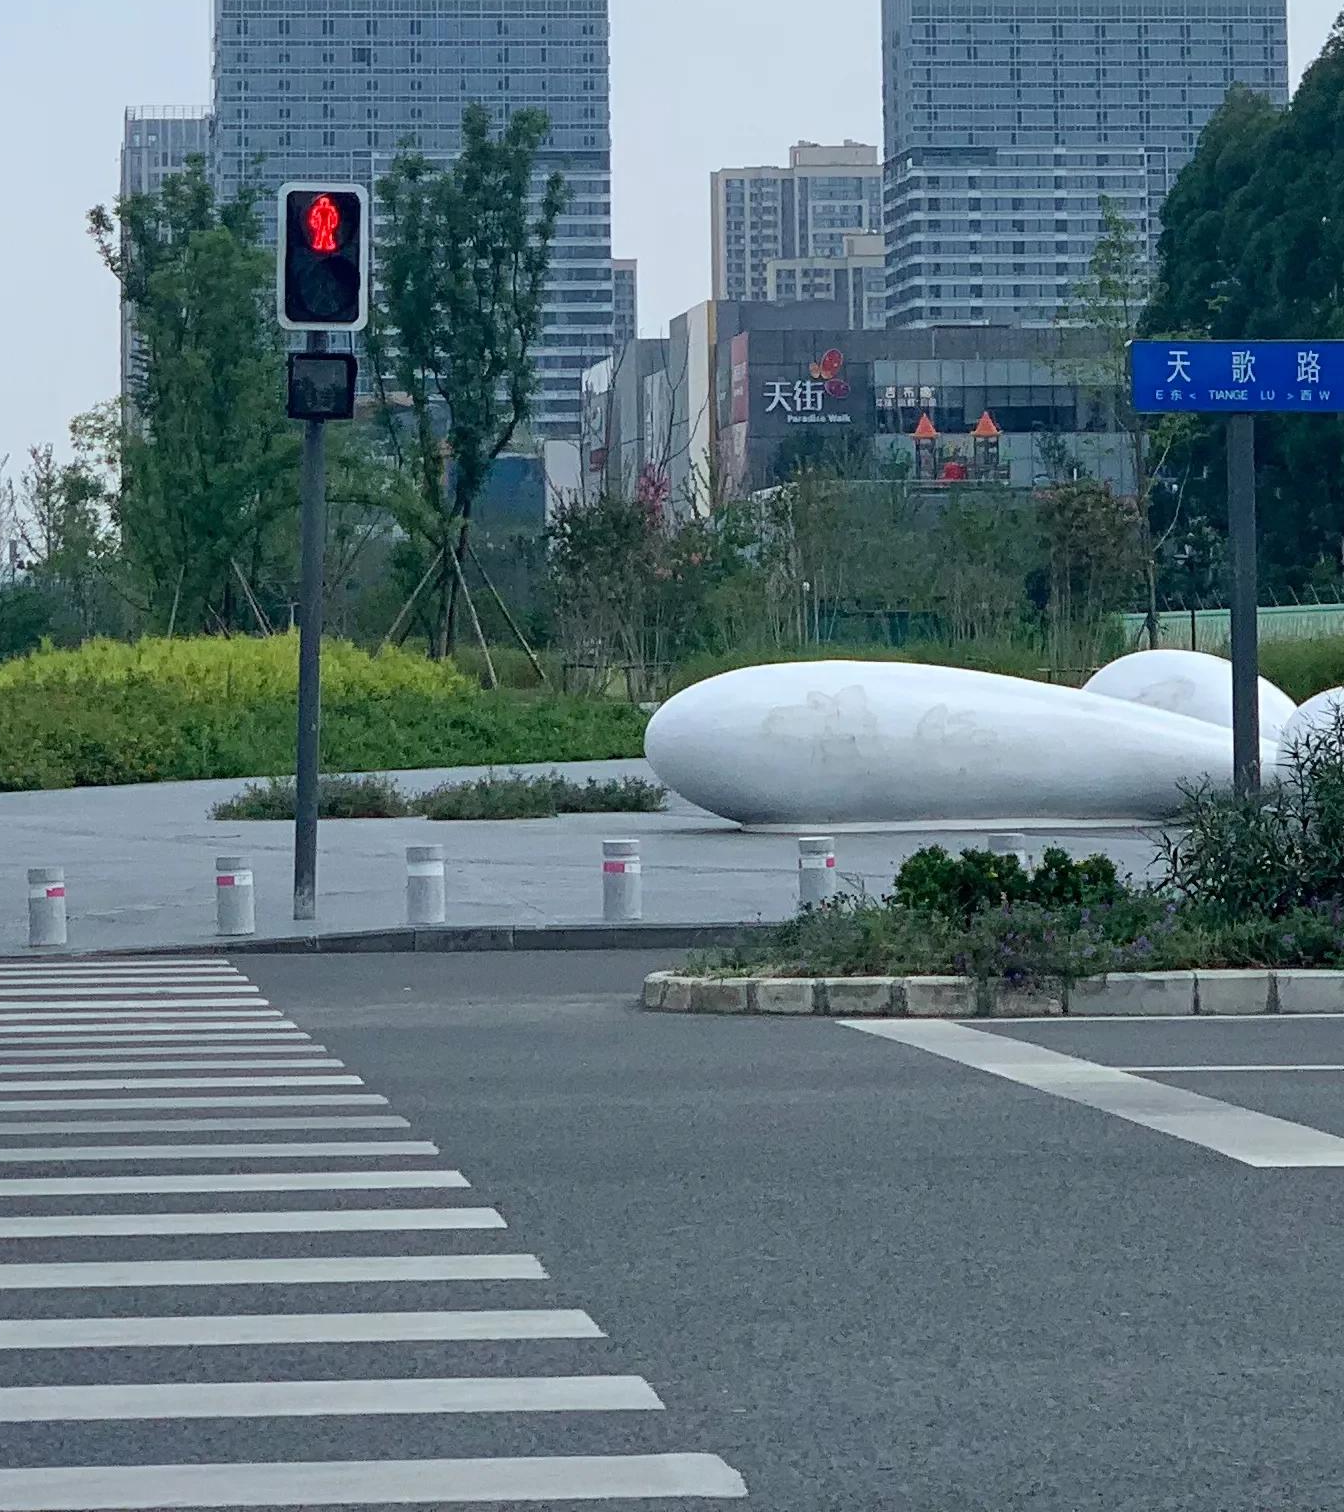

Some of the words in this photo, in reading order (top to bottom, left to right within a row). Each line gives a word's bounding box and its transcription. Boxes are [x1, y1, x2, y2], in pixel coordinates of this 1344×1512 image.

[1167, 350, 1322, 383] 天歌路
[762, 379, 825, 412] 天街
[1155, 389, 1164, 400] E
[1208, 389, 1249, 401] TIANGE
[1260, 390, 1276, 401] LU
[1300, 390, 1312, 401] 西
[1319, 390, 1331, 401] W
[787, 414, 826, 423] Paradise
[828, 414, 852, 423] Walk
